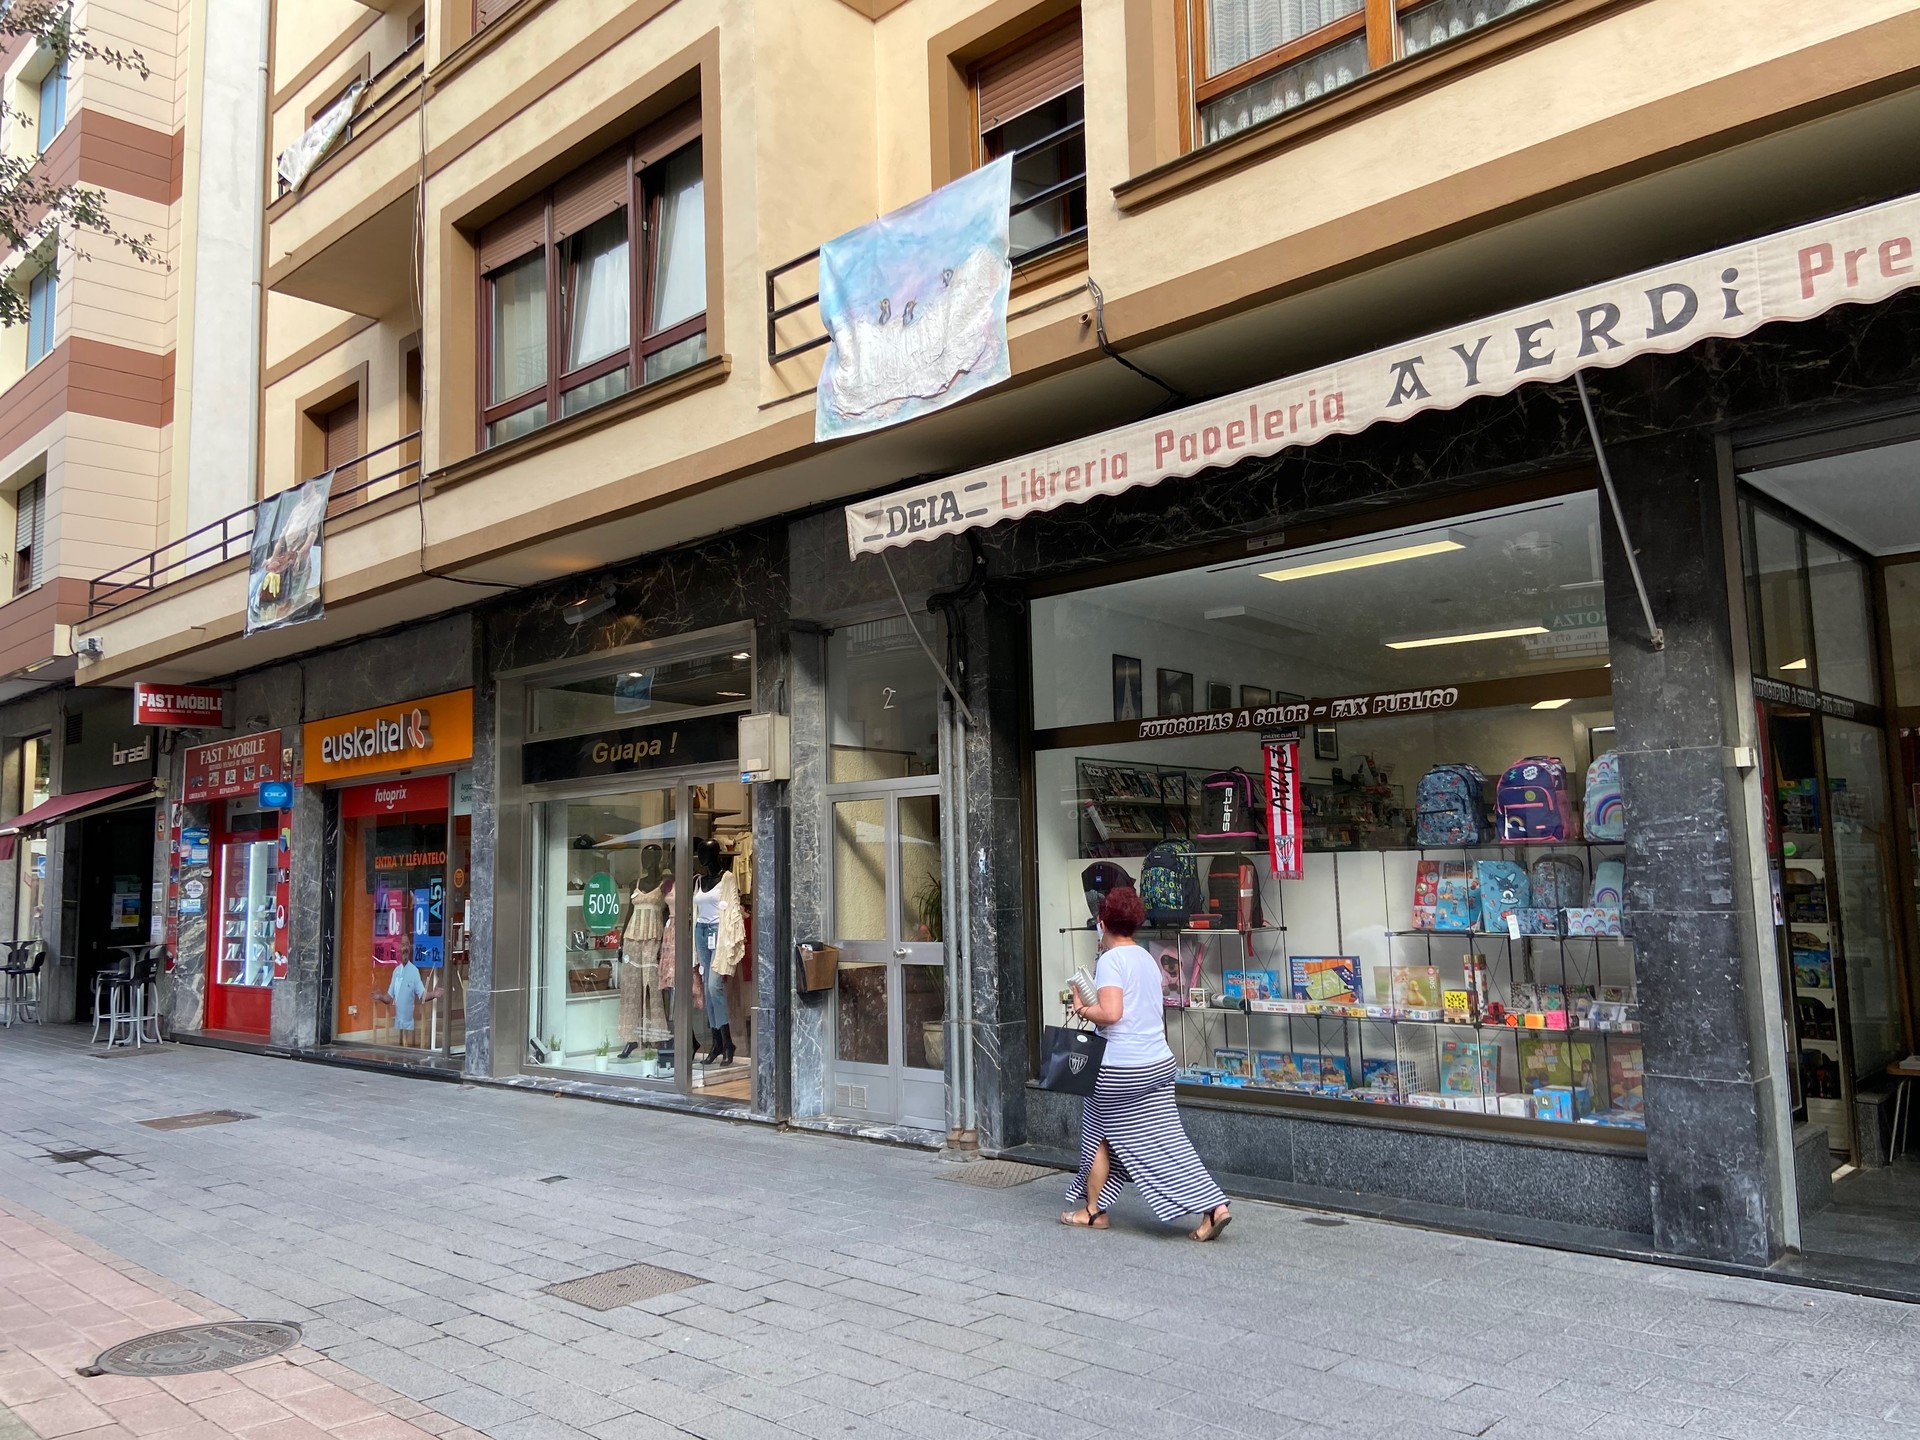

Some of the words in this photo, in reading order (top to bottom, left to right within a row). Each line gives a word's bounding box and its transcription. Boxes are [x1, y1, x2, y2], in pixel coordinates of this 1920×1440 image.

[886, 490, 964, 538] DEIA
[1001, 448, 1128, 511] Libreria
[1797, 235, 1915, 300] Pre
[139, 692, 174, 708] FAST
[882, 686, 896, 710] 2
[1139, 712, 1234, 738] FOTOCOPIAS
[1236, 710, 1250, 728] A
[1253, 703, 1309, 726] COLOR
[1330, 697, 1370, 719] FAX
[1372, 687, 1458, 714] PUBLICO
[112, 735, 150, 766] brasil
[322, 713, 404, 763] euskaltel
[200, 747, 224, 765] FAST
[592, 738, 662, 764] Guapa
[374, 785, 408, 807] fotoprix
[1222, 787, 1233, 832] safta
[375, 855, 397, 870] ENTRA
[399, 855, 404, 866] Y
[405, 850, 446, 866] LLÉVATELO
[588, 893, 619, 915] 50%
